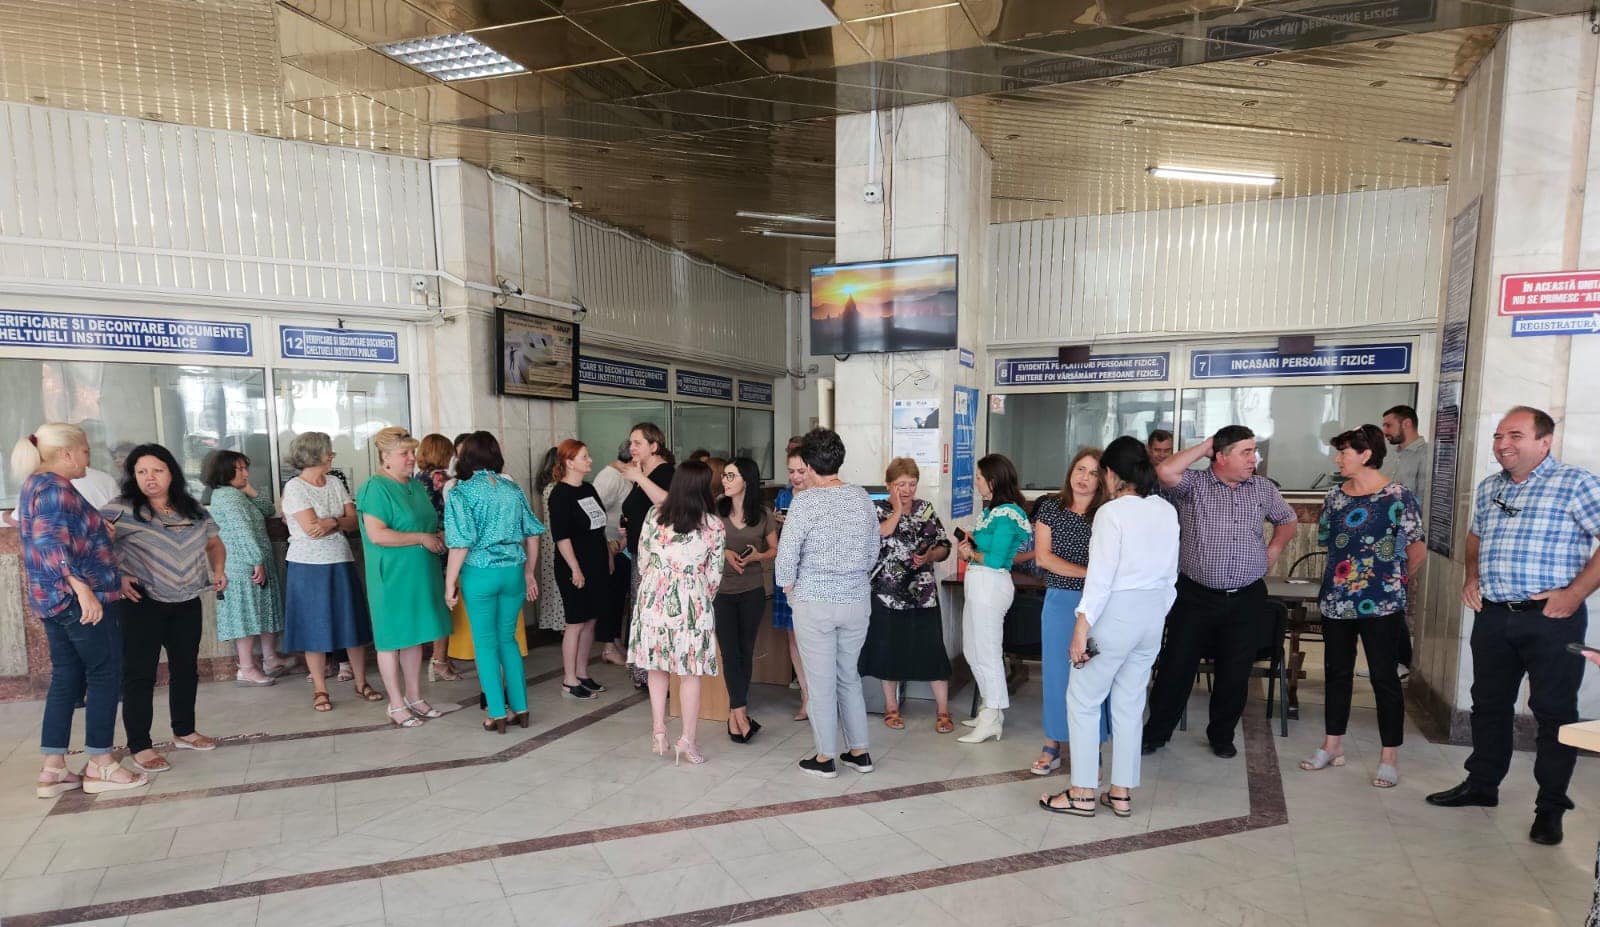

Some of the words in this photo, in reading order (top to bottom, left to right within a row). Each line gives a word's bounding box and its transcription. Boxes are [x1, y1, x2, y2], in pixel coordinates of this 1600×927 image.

[1534, 278, 1576, 292] ACEASTĂ
[1512, 295, 1526, 305] NU
[1527, 294, 1539, 304] SE
[1540, 292, 1579, 303] PRIMESC
[71, 318, 86, 331] SI
[88, 319, 166, 335] DECONTARE
[168, 323, 245, 339] DOCUMENTE
[71, 331, 142, 347] INSTITUTII
[144, 335, 198, 349] PUBLICE
[286, 337, 304, 350] 12
[1051, 362, 1060, 370] PE
[1096, 359, 1133, 369] PERSOANE
[1199, 362, 1207, 371] 7
[1231, 357, 1280, 370] INCASARI
[1281, 356, 1338, 368] PERSOANE
[1340, 354, 1376, 366] FIZICE
[1000, 368, 1008, 378] 8
[1044, 373, 1056, 381] FOI
[1099, 370, 1135, 379] PERSOANE
